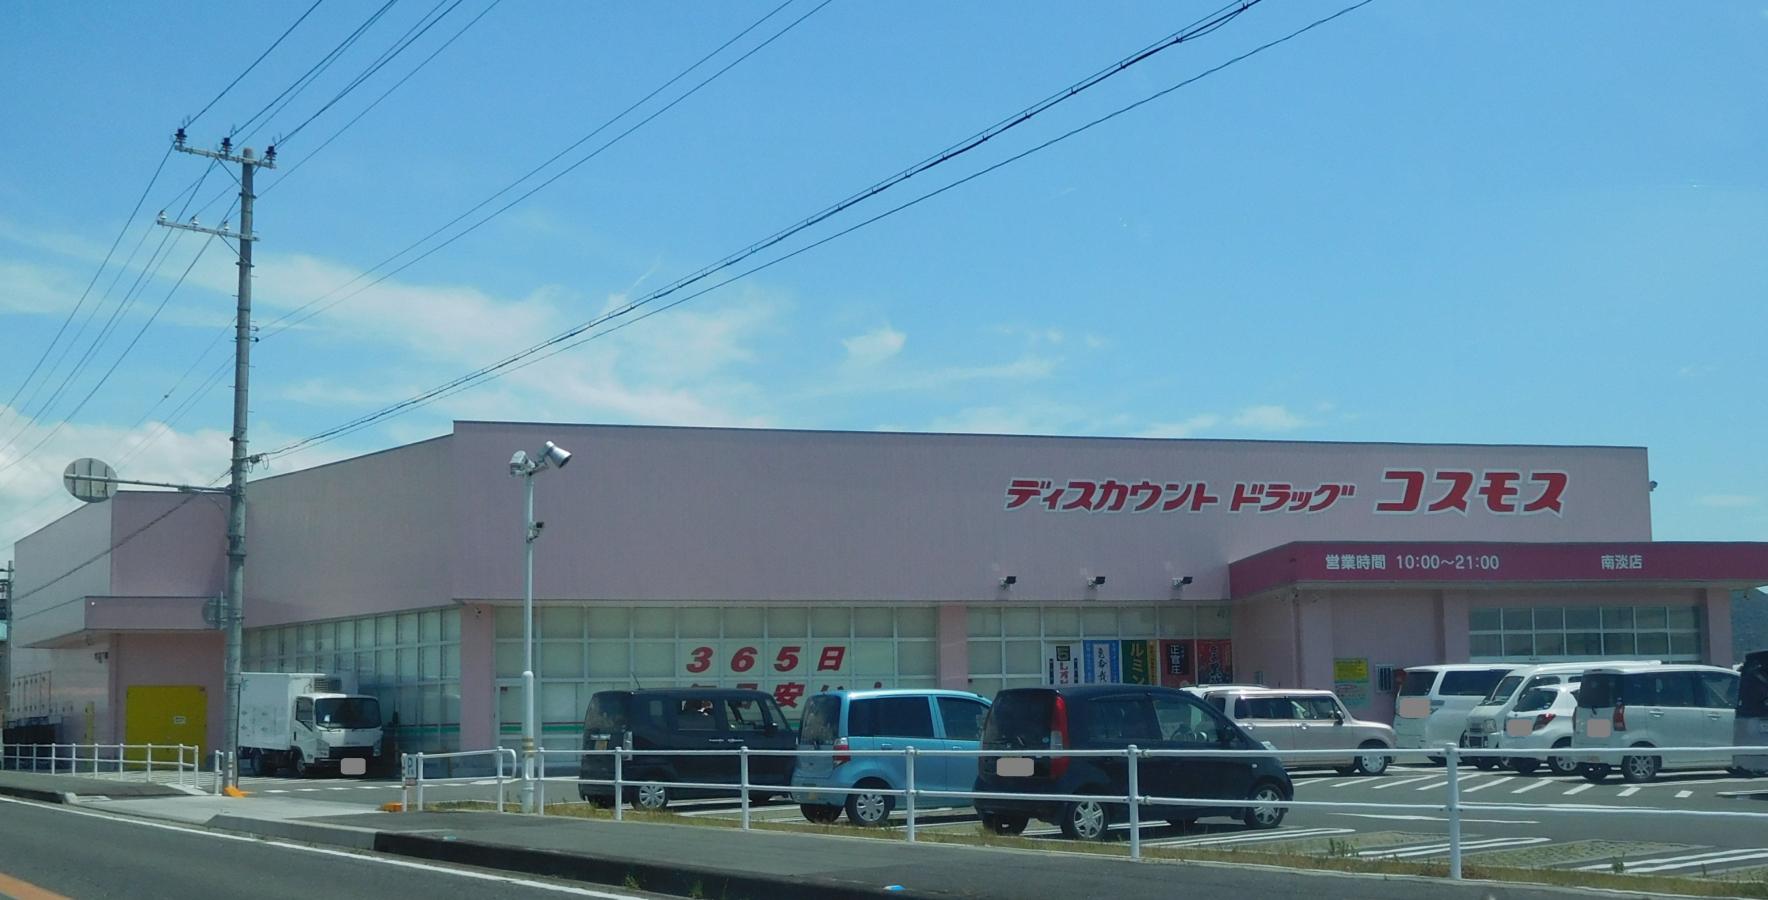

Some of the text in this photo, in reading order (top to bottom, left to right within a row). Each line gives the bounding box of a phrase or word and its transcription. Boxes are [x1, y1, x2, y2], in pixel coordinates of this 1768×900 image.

[1005, 469, 1568, 515] ディスカウント ドラッグ コスモス
[1325, 554, 1386, 570] 営業時間
[1601, 554, 1642, 570] 南淡店
[686, 646, 846, 673] 365日
